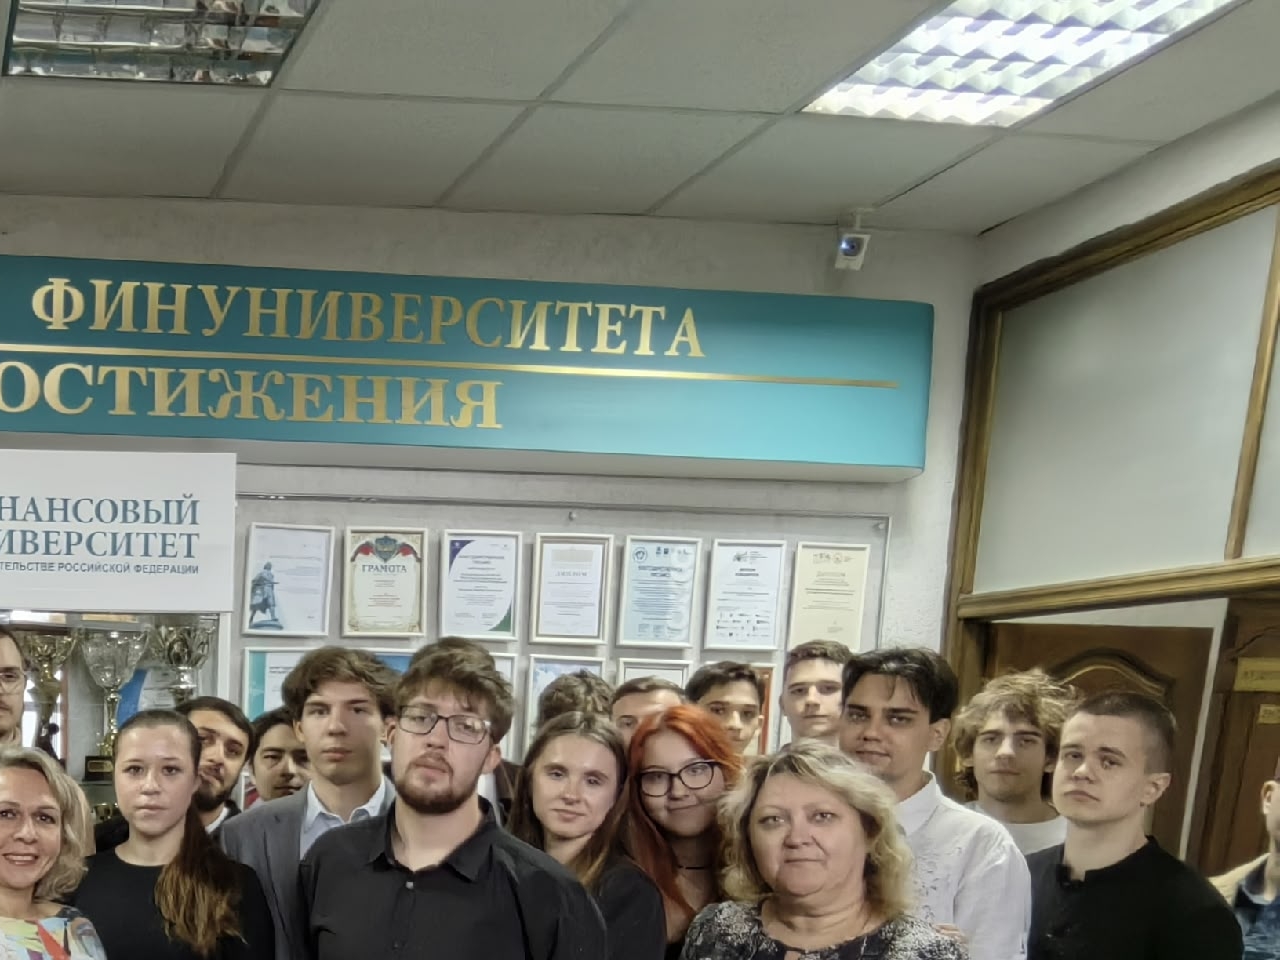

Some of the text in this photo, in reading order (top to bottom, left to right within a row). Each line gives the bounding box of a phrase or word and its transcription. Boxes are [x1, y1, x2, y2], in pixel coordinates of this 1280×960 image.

[31, 277, 705, 357] ФИНУНИВЕРСИТЕТА
[57, 561, 131, 574] РОССИЙСКОЙ
[133, 563, 199, 575] ФЕДЕРАЦИИ
[361, 564, 408, 574] ГРАМОТА
